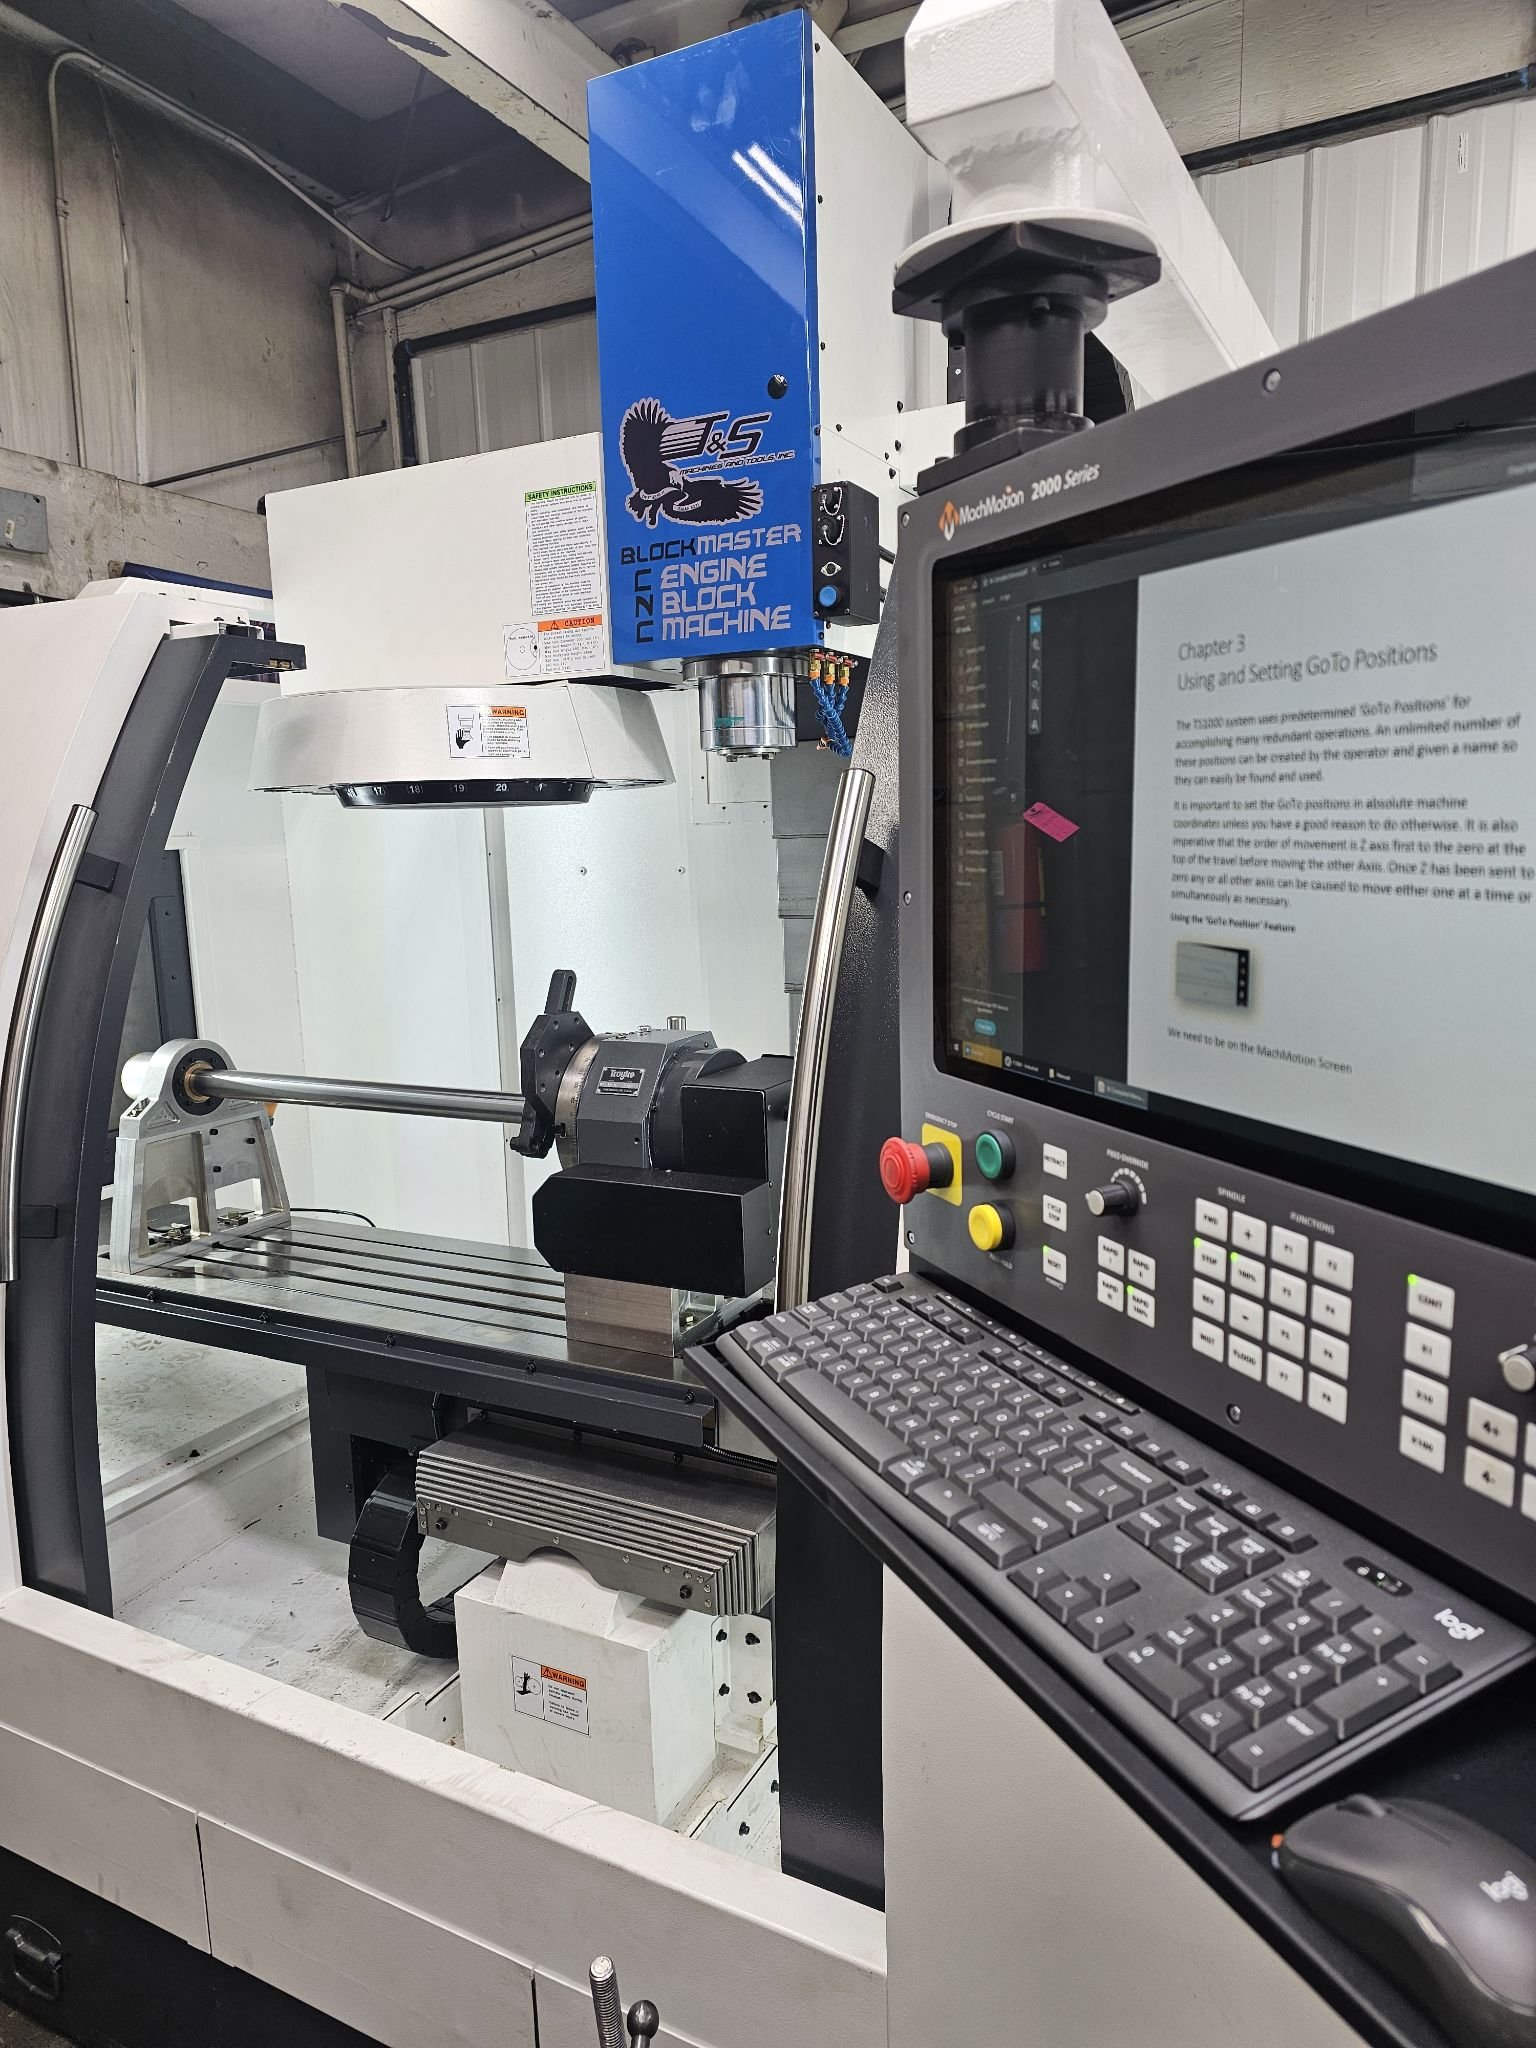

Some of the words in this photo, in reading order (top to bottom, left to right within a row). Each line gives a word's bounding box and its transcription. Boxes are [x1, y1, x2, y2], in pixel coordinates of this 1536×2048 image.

[695, 413, 770, 460] T&S
[679, 463, 722, 475] MACHINES
[725, 460, 742, 468] AND
[528, 491, 549, 500] SAFETY
[551, 484, 593, 497] INSTRUCTIONS
[959, 485, 1024, 525] MachMotion
[1031, 474, 1062, 501] 2000
[1063, 463, 1100, 489] Series
[620, 523, 801, 565] BLOCKMASTER
[660, 553, 768, 589] ENGINE
[662, 582, 756, 614] BLOCK
[564, 617, 595, 626] CAUTION
[662, 605, 792, 640] MACHINE
[1178, 639, 1234, 661] Chapter
[1236, 633, 1246, 653] 3
[1178, 672, 1215, 692] Using
[1218, 664, 1246, 686] and
[1248, 659, 1303, 682] Setting
[1305, 651, 1351, 676] GoTo
[1353, 643, 1438, 670] Positions
[1176, 719, 1191, 731] The
[1225, 715, 1256, 728] system
[1281, 704, 1356, 724] predetermined
[1453, 693, 1472, 710] for
[1176, 736, 1233, 749] accomplishing
[1236, 735, 1259, 745] many
[1262, 729, 1312, 743] redundant
[1375, 723, 1391, 736] An
[1395, 719, 1450, 736] unlimited
[1453, 716, 1502, 732] number
[1507, 712, 1521, 729] of
[1175, 757, 1196, 768] these
[1199, 754, 1236, 767] positions
[1238, 756, 1254, 765] can
[1256, 752, 1268, 764] be
[1270, 749, 1306, 762] created
[1309, 749, 1320, 763] by
[1323, 748, 1340, 761] the
[1343, 746, 1389, 761] operator
[1393, 742, 1415, 758] and
[1416, 742, 1449, 760] given
[1452, 742, 1459, 754] a
[1463, 740, 1499, 754] name
[1502, 739, 1519, 753] so
[1174, 775, 1192, 786] they
[1194, 775, 1208, 785] can
[1210, 773, 1233, 786] easily
[1236, 772, 1248, 784] be
[1250, 770, 1276, 783] found
[1279, 769, 1297, 782] and
[409, 785, 420, 793] 18
[453, 784, 465, 793] 19
[495, 784, 508, 792] 20
[1190, 800, 1230, 812] important
[1233, 800, 1242, 809] to
[1244, 800, 1258, 809] set
[1260, 799, 1275, 809] the
[1278, 797, 1301, 810] GoTo
[1305, 798, 1349, 811] positions
[1354, 799, 1363, 809] in
[1366, 795, 1413, 809] absolute
[1417, 794, 1469, 809] machine
[1173, 819, 1220, 829] coordinates
[1222, 819, 1248, 829] unless
[1252, 820, 1268, 833] you
[1270, 819, 1293, 830] have
[1303, 817, 1329, 831] good
[1369, 819, 1380, 831] to
[1384, 817, 1398, 831] do
[1492, 817, 1519, 833] also
[1173, 836, 1215, 849] imperative
[1218, 837, 1235, 847] that
[1237, 836, 1251, 848] the
[1254, 837, 1279, 848] order
[1281, 836, 1291, 848] of
[1294, 840, 1347, 850] movement
[1369, 840, 1390, 850] axis
[1393, 837, 1415, 850] first
[1418, 840, 1431, 851] to
[1434, 838, 1454, 852] the
[1456, 842, 1485, 855] zero
[1487, 841, 1500, 854] at
[1503, 841, 1527, 856] the
[1172, 854, 1185, 866] top
[1199, 854, 1210, 865] the
[1213, 854, 1238, 866] travel
[1240, 855, 1269, 868] before
[1272, 858, 1305, 871] moving
[1308, 858, 1324, 870] the
[1328, 858, 1354, 872] other
[1386, 859, 1418, 874] Once
[1431, 862, 1450, 875] has
[1454, 863, 1485, 878] been
[1488, 866, 1516, 879] sent
[1520, 866, 1536, 881] to
[1171, 872, 1189, 883] zero
[1191, 873, 1205, 885] any
[1230, 874, 1253, 886] other
[1278, 878, 1293, 888] can
[1297, 878, 1309, 890] be
[1311, 880, 1346, 892] caused
[1348, 881, 1360, 892] to
[1363, 883, 1393, 896] move
[1396, 884, 1429, 897] either
[1432, 886, 1455, 900] one
[1458, 887, 1470, 901] at
[1474, 889, 1481, 901] a
[1484, 887, 1515, 903] time
[1171, 889, 1231, 904] simultaneously
[1170, 913, 1189, 925] Using
[1192, 913, 1202, 924] the
[1264, 922, 1296, 933] Feature
[1168, 1026, 1181, 1038] We
[1183, 1030, 1202, 1043] need
[1204, 1034, 1213, 1045] to
[1215, 1035, 1226, 1048] be
[1228, 1040, 1239, 1050] on
[1240, 1040, 1254, 1053] the
[1256, 1044, 1317, 1066] MachMotion
[1318, 1056, 1353, 1074] Screen
[1044, 1155, 1064, 1166] RETRACT
[1121, 1153, 1149, 1170] OVERRIDE
[1218, 1187, 1246, 1204] SPINDLE
[1047, 1203, 1061, 1213] CYCLE
[1049, 1213, 1060, 1221] STOP
[1204, 1214, 1218, 1225] FWD
[1290, 1212, 1335, 1235] FUNCTIONS
[1103, 1245, 1119, 1256] RAPID
[1284, 1244, 1293, 1254] F1
[1048, 1259, 1061, 1269] RESET
[1133, 1258, 1150, 1270] RAPID
[1201, 1254, 1218, 1265] STOP
[1327, 1259, 1337, 1271] F2
[1238, 1270, 1256, 1282] 100%
[1102, 1281, 1118, 1292] RAPID
[1133, 1295, 1149, 1308] RAPID
[1202, 1295, 1215, 1305] REV
[1325, 1304, 1335, 1315] F4
[1200, 1333, 1215, 1344] MIST
[1233, 1350, 1256, 1366] FLOOD
[1279, 1372, 1288, 1382] F7
[1433, 1607, 1486, 1642] logi
[552, 1673, 584, 1688] WARNING
